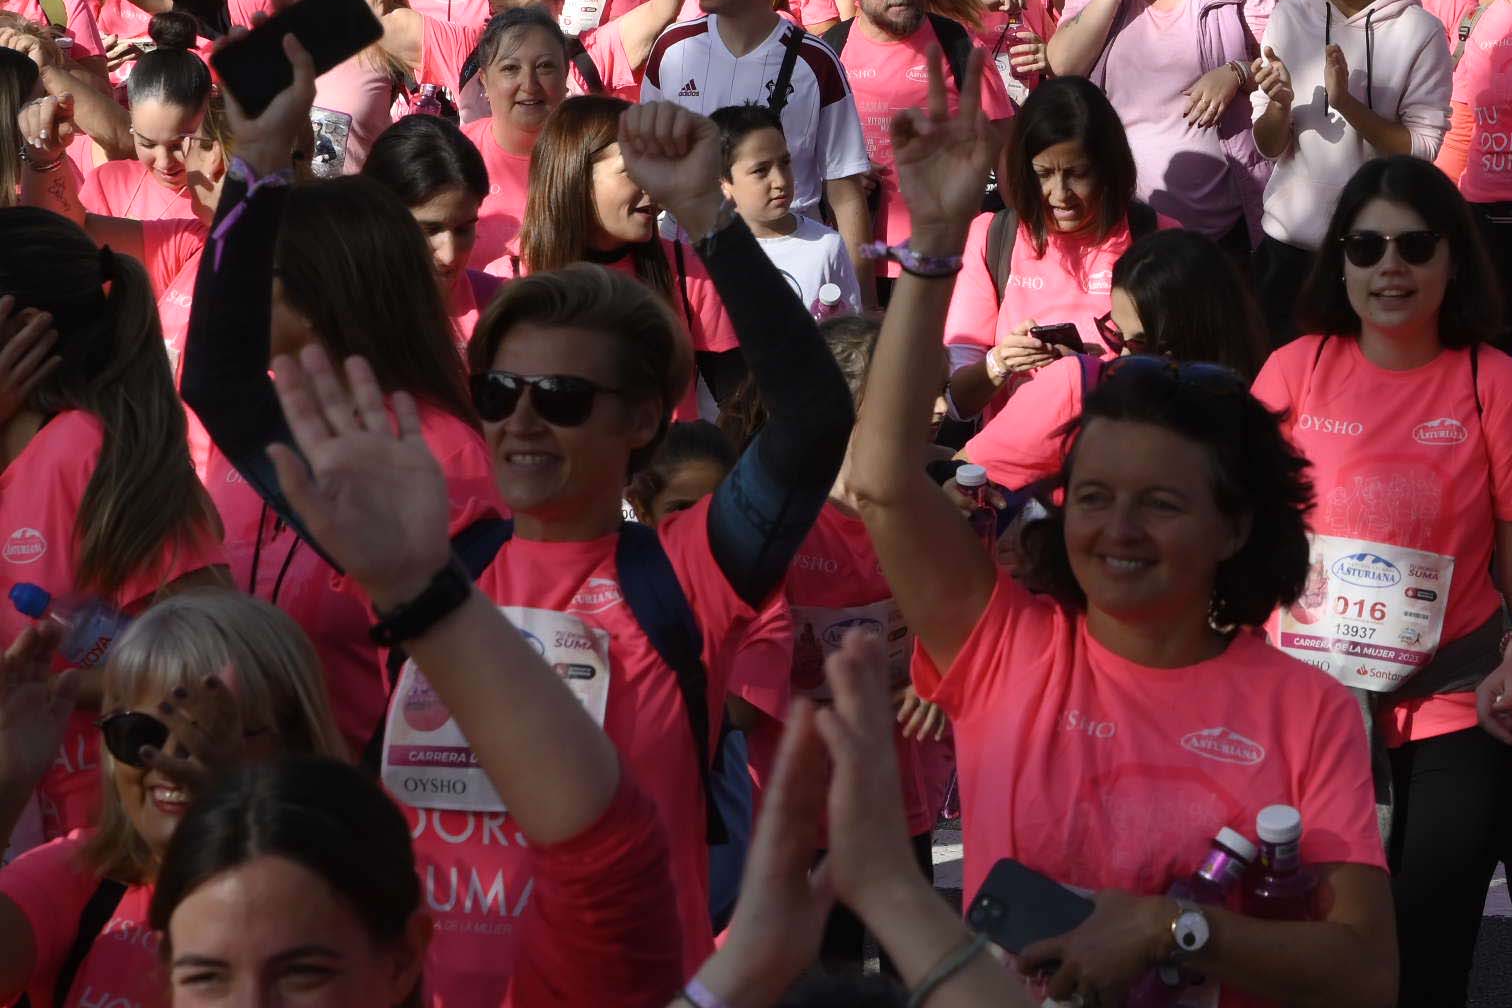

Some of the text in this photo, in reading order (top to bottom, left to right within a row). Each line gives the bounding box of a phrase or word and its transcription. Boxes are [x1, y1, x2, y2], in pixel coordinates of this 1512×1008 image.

[1474, 106, 1499, 126] TU
[1300, 414, 1364, 436] OYSHO
[1338, 563, 1397, 584] ASTURIANA
[1407, 569, 1440, 581] SUMA
[1336, 595, 1389, 623] 016
[1336, 623, 1376, 641] 13937
[1294, 637, 1332, 649] CARRERA
[1335, 640, 1348, 652] DE
[1349, 642, 1361, 654] LA
[1363, 645, 1396, 660] MUJER
[408, 751, 466, 763] CARRERA
[404, 777, 466, 795] OYSHO
